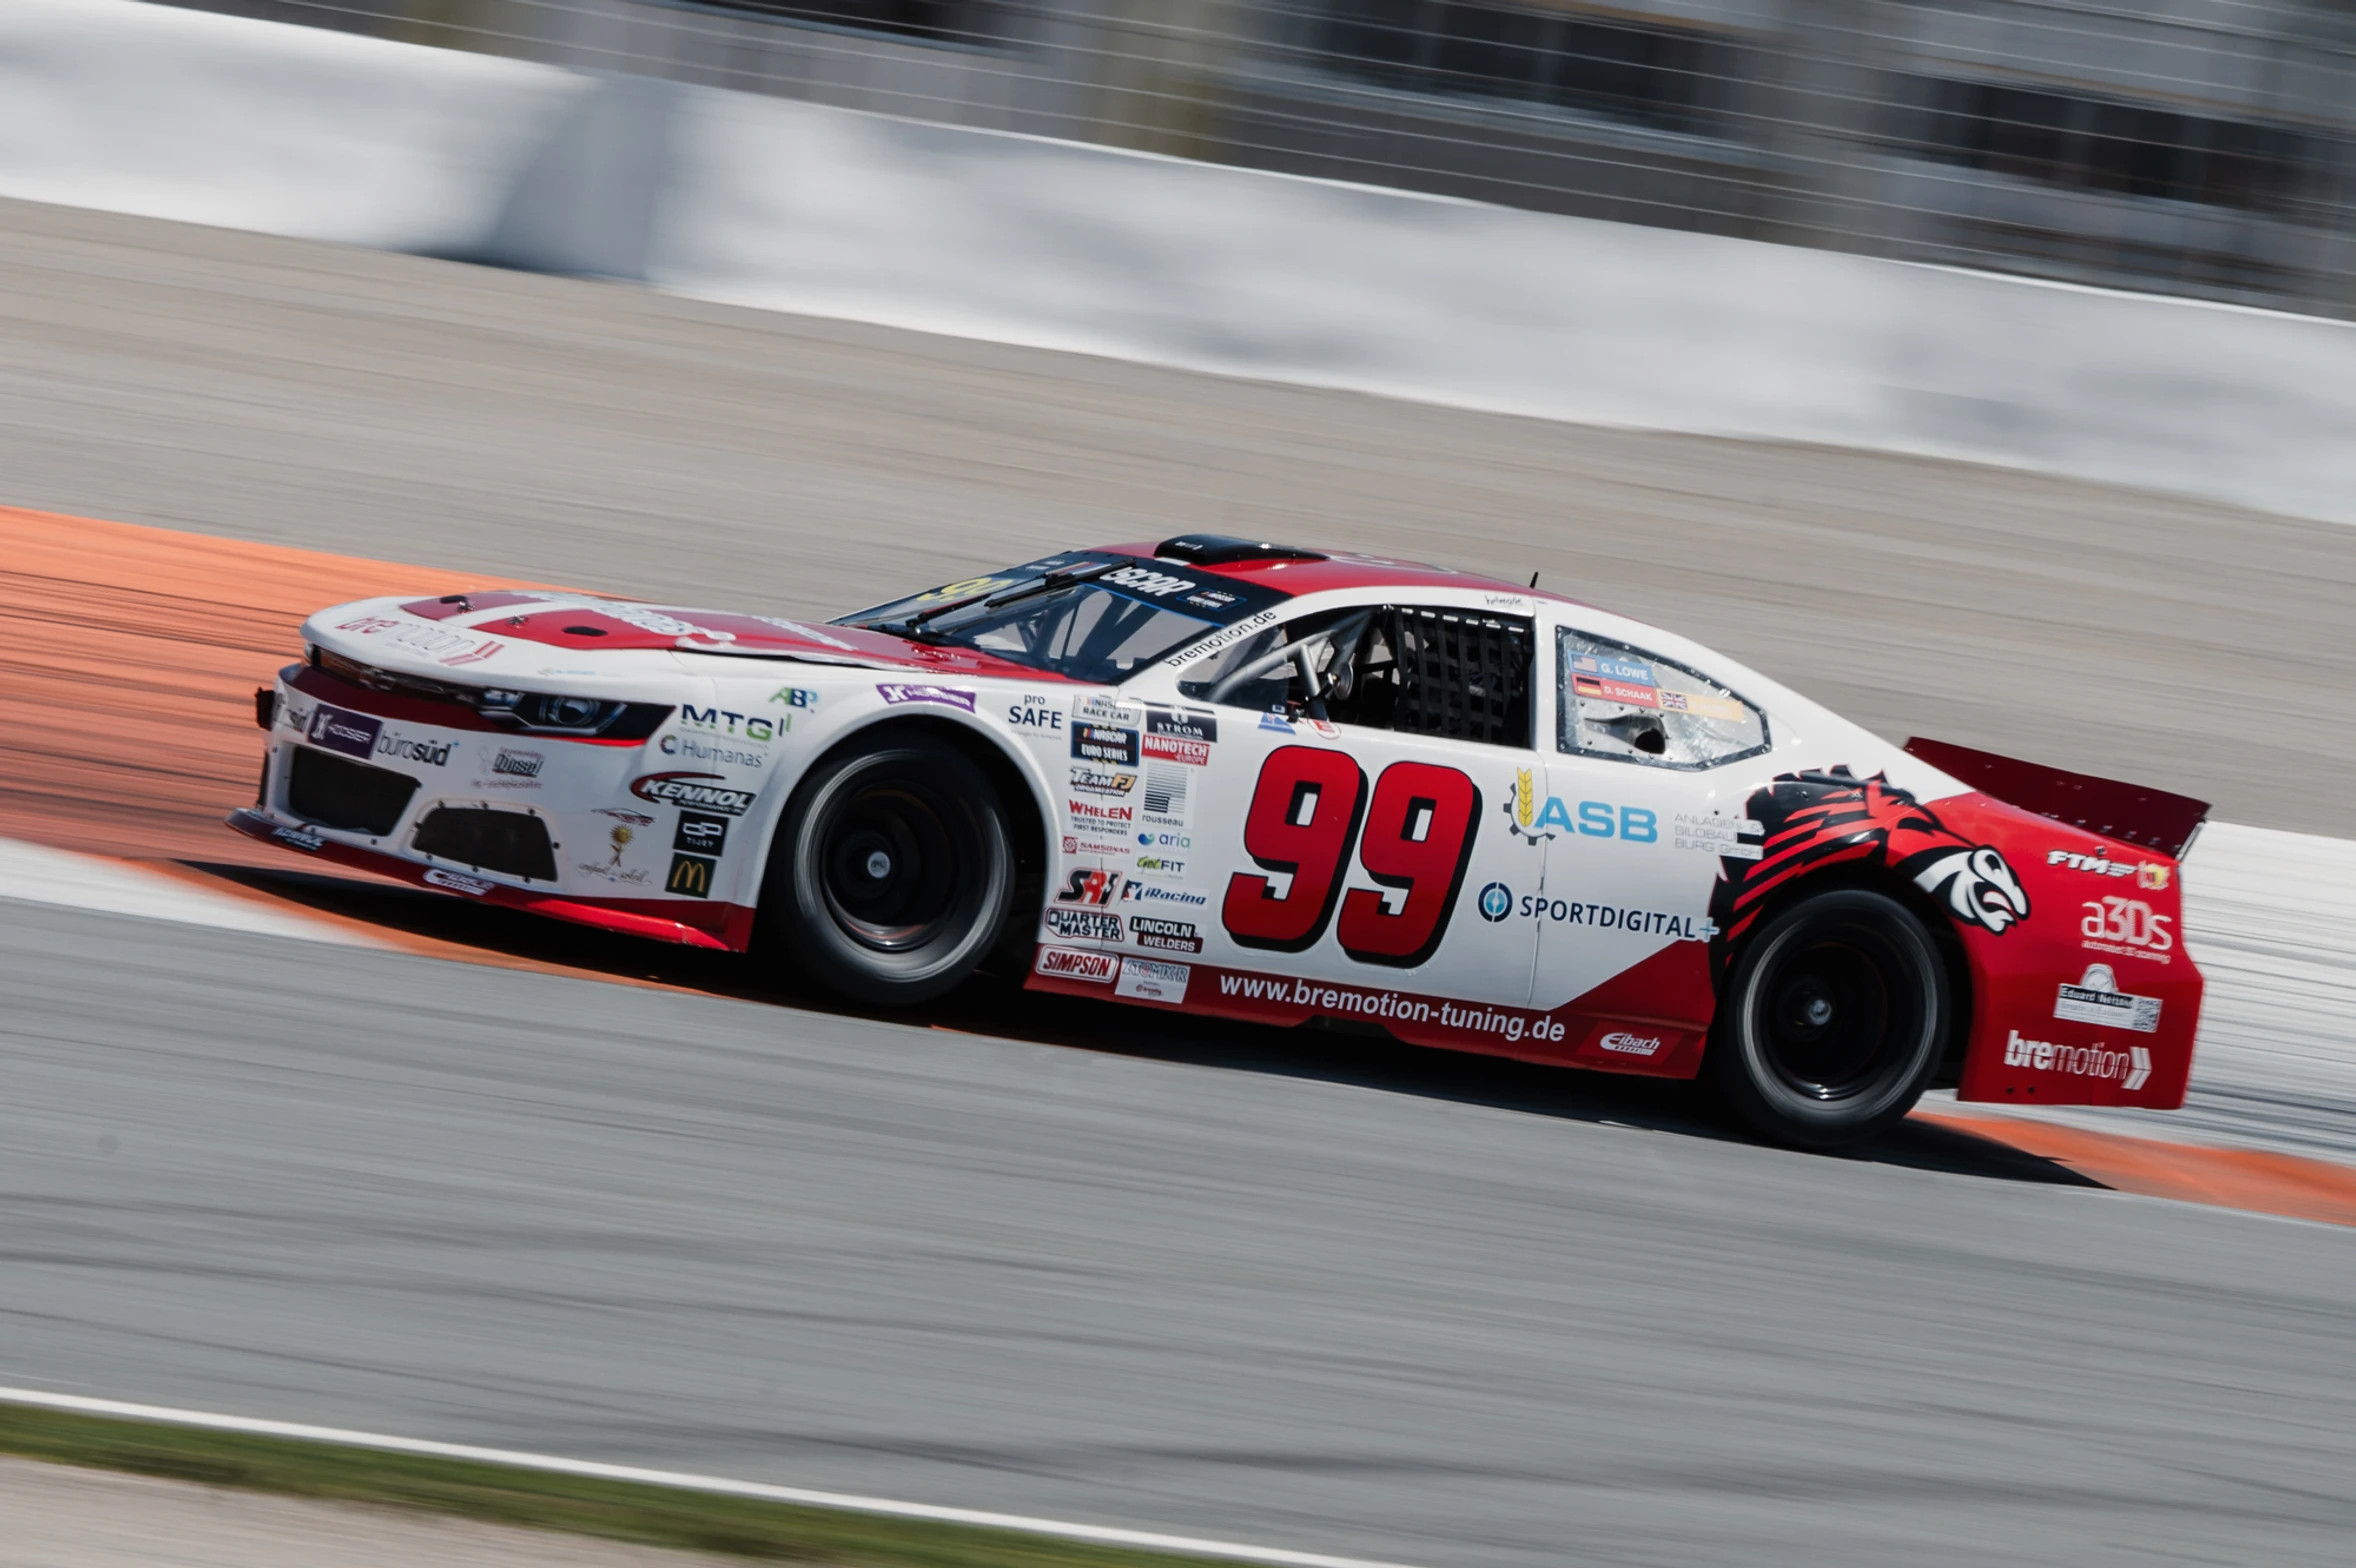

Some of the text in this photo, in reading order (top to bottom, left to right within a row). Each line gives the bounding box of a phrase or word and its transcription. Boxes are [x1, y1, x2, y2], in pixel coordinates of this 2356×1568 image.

[1168, 610, 1277, 667] bremotion.de
[1601, 662, 1649, 681] G. LOWE
[1023, 694, 1046, 706] pro
[1616, 687, 1653, 702] SCHAAK
[681, 703, 774, 742] MTG
[1008, 706, 1062, 730] SAFE
[1082, 706, 1130, 721] RACE CAR
[1093, 728, 1128, 745] NASCAR
[1156, 721, 1204, 737] STROM
[376, 729, 454, 768] bürosüd
[681, 738, 763, 769] Humanas
[1081, 743, 1129, 762] EURO SERIES
[1145, 736, 1209, 758] NANOTECH
[641, 778, 752, 809] KENNOL
[1069, 799, 1133, 821] WHELEN
[1106, 820, 1131, 829] PROTECT
[1142, 813, 1184, 827] rousseau
[1533, 796, 1659, 844] ASB
[1091, 826, 1128, 837] RESPONDERS
[1159, 832, 1191, 849] aria
[1674, 825, 1738, 842] SILOBAU
[1674, 837, 1716, 853] BURG
[1221, 744, 1483, 970] 99
[2047, 850, 2112, 875] FTM
[1144, 887, 1207, 906] iRacing
[1047, 910, 1119, 930] QUARTER
[1132, 919, 1193, 938] LINCOLN
[1059, 922, 1121, 941] MASTER
[1143, 935, 1196, 952] WELDERS
[1043, 951, 1112, 977] SIMPSON
[1219, 974, 1566, 1042] www.bremotion-tuning.de
[2003, 1029, 2130, 1080] bremotion
